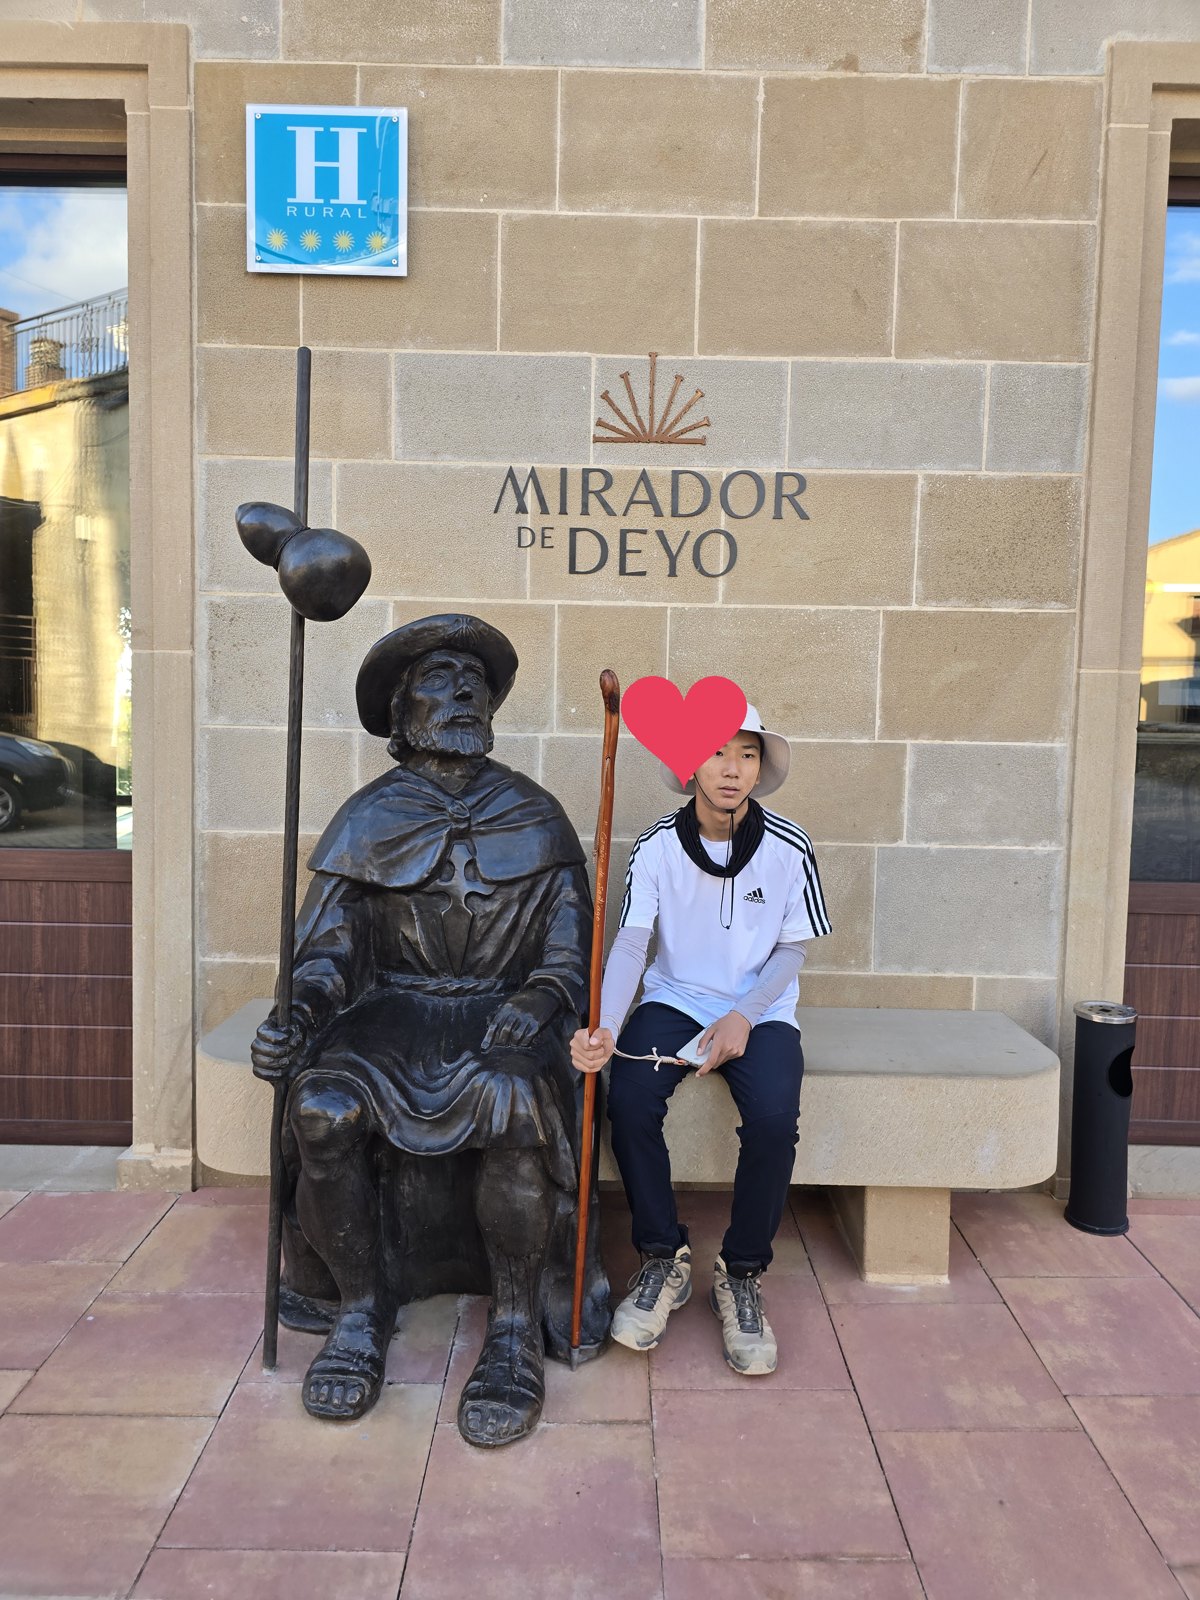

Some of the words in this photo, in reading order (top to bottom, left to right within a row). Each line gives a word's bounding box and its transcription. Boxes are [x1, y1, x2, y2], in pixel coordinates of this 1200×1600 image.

[286, 126, 368, 205] H
[286, 206, 367, 218] RURAL
[493, 465, 810, 520] MIRADOR
[517, 526, 554, 549] DE
[568, 527, 738, 578] DEYO
[743, 895, 766, 905] adidas
